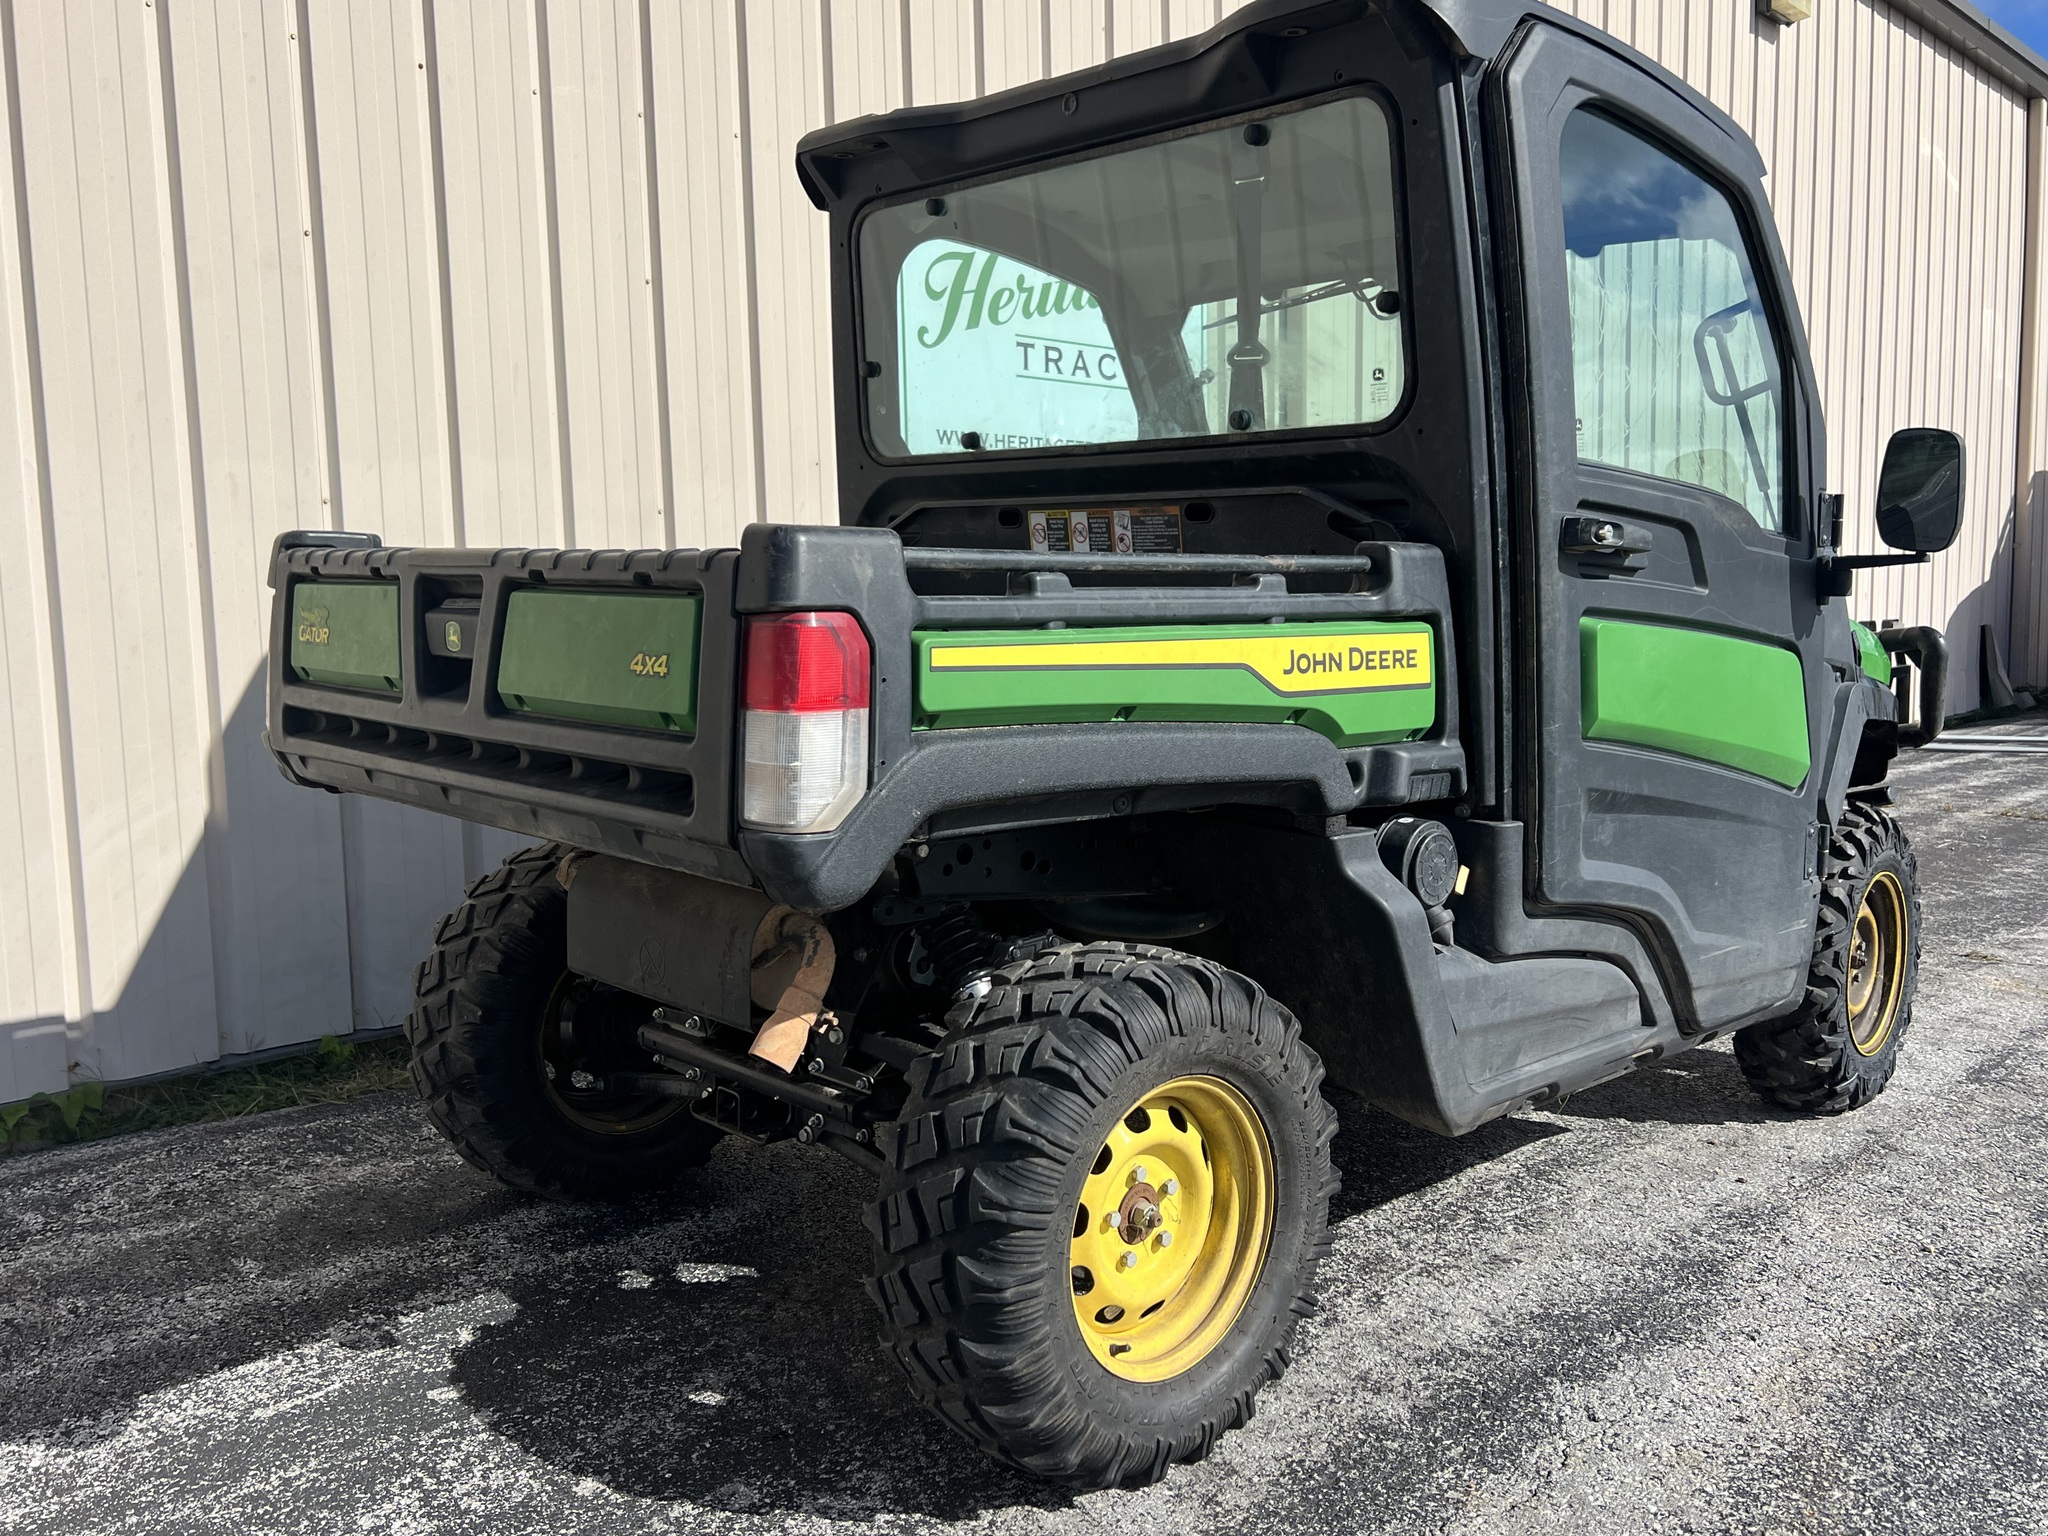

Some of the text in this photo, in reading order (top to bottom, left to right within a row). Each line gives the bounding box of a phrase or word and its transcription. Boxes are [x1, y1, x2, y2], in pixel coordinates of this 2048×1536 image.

[1016, 341, 1117, 381] TRAC
[299, 625, 329, 643] GATOR
[1283, 647, 1418, 675] JOHN DEERE
